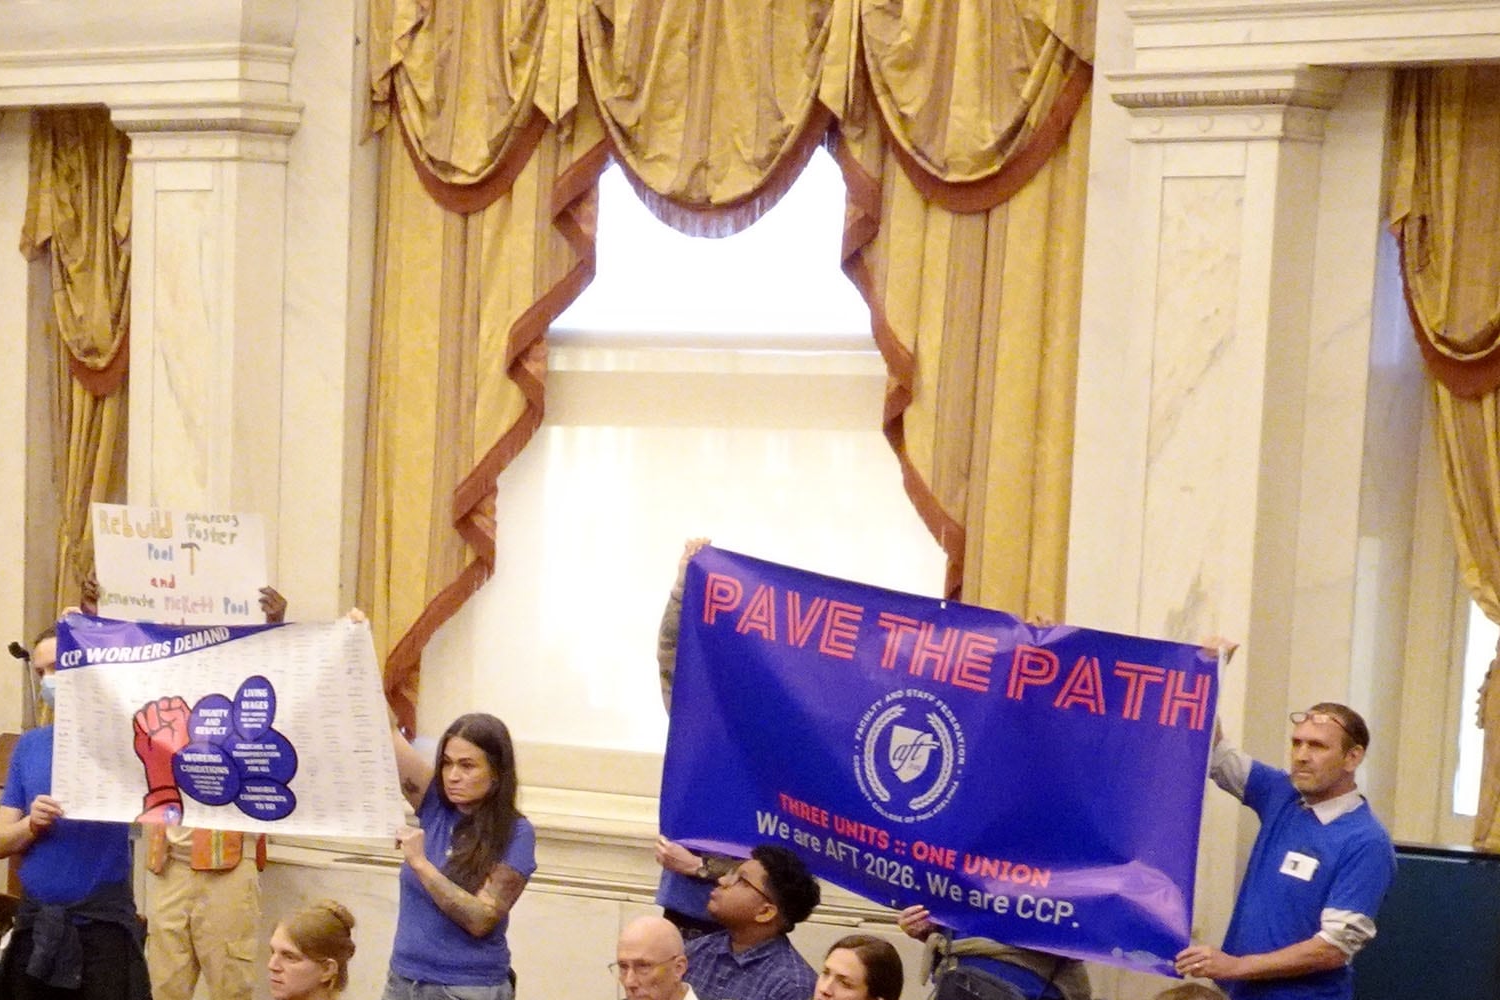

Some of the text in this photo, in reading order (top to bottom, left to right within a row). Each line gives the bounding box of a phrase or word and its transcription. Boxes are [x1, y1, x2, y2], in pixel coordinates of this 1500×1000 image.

[98, 507, 174, 539] Rebuild
[187, 524, 239, 545] Foster
[147, 542, 174, 561] Pool
[150, 574, 176, 589] and
[222, 596, 249, 616] Pool
[60, 627, 230, 668] CCP WORKERS DEMAND
[703, 572, 1212, 731] PAVE THE PATH
[199, 708, 229, 717] DIGNITY
[204, 718, 221, 726] AND
[194, 726, 227, 735] RESPECT
[855, 689, 966, 765] FACULTY AND STAFF FEDERATION
[182, 753, 222, 763] WORKING
[778, 791, 830, 829] THREE
[833, 814, 890, 850] UNITS
[912, 841, 956, 870] ONE
[963, 853, 1051, 889] UNION
[756, 810, 1080, 928] We are AFT 2026. We are CCP.
